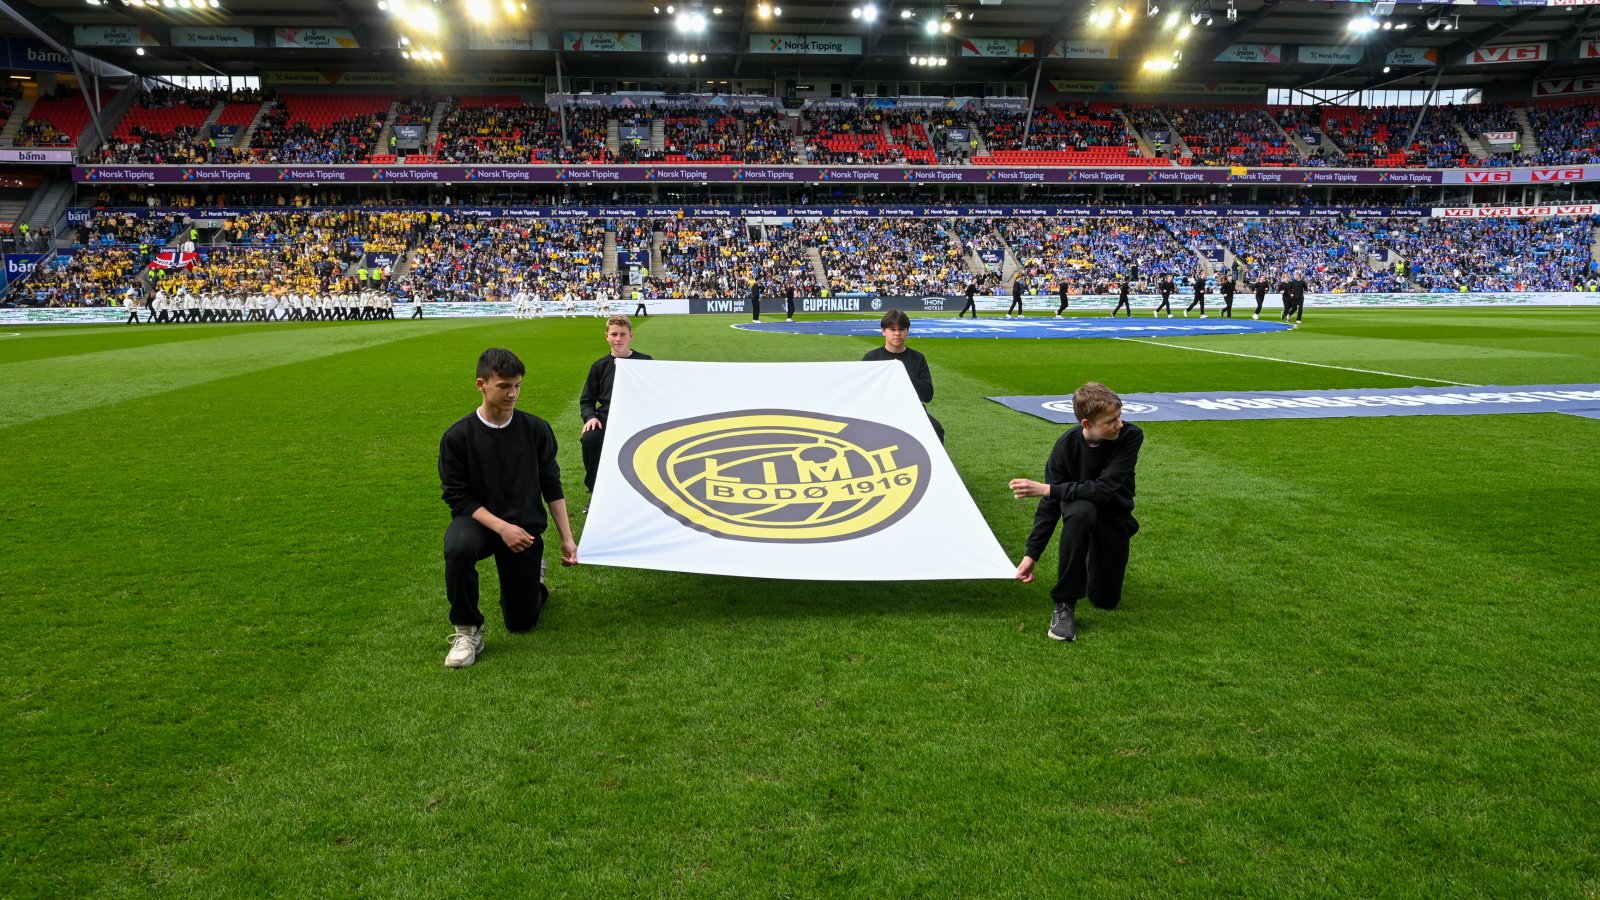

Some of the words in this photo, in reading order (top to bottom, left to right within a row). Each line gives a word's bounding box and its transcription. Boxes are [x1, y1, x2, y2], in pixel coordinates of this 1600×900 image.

[785, 41, 809, 49] Norsk
[811, 41, 842, 52] Tipping
[1475, 46, 1539, 61] VG
[99, 170, 123, 178] Norsk
[124, 170, 154, 179] Tipping
[196, 170, 220, 178] Norsk
[220, 170, 250, 179] Tipping
[292, 170, 315, 178] Norsk
[315, 170, 345, 180] Tipping
[409, 171, 438, 180] Tipping
[501, 171, 529, 180] Tipping
[591, 171, 619, 180] Tipping
[680, 171, 707, 180] Tipping
[767, 171, 793, 180] Tipping
[831, 171, 852, 179] Norsk
[853, 171, 878, 180] Tipping
[937, 172, 962, 181] Tipping
[1020, 172, 1044, 181] Tipping
[1101, 172, 1125, 181] Tipping
[1160, 172, 1180, 180] Norsk
[1180, 172, 1204, 182] Tipping
[1257, 173, 1281, 182] Tipping
[1336, 173, 1357, 182] Tipping
[1411, 174, 1432, 183] Tipping
[1466, 172, 1511, 182] VG
[1532, 169, 1583, 181] VG
[1479, 208, 1511, 216] VG
[1557, 206, 1592, 214] VG
[707, 300, 732, 312] KIWI
[803, 299, 860, 311] CUPFINALEN
[713, 485, 829, 500] BODØ
[841, 473, 912, 497] 1916
